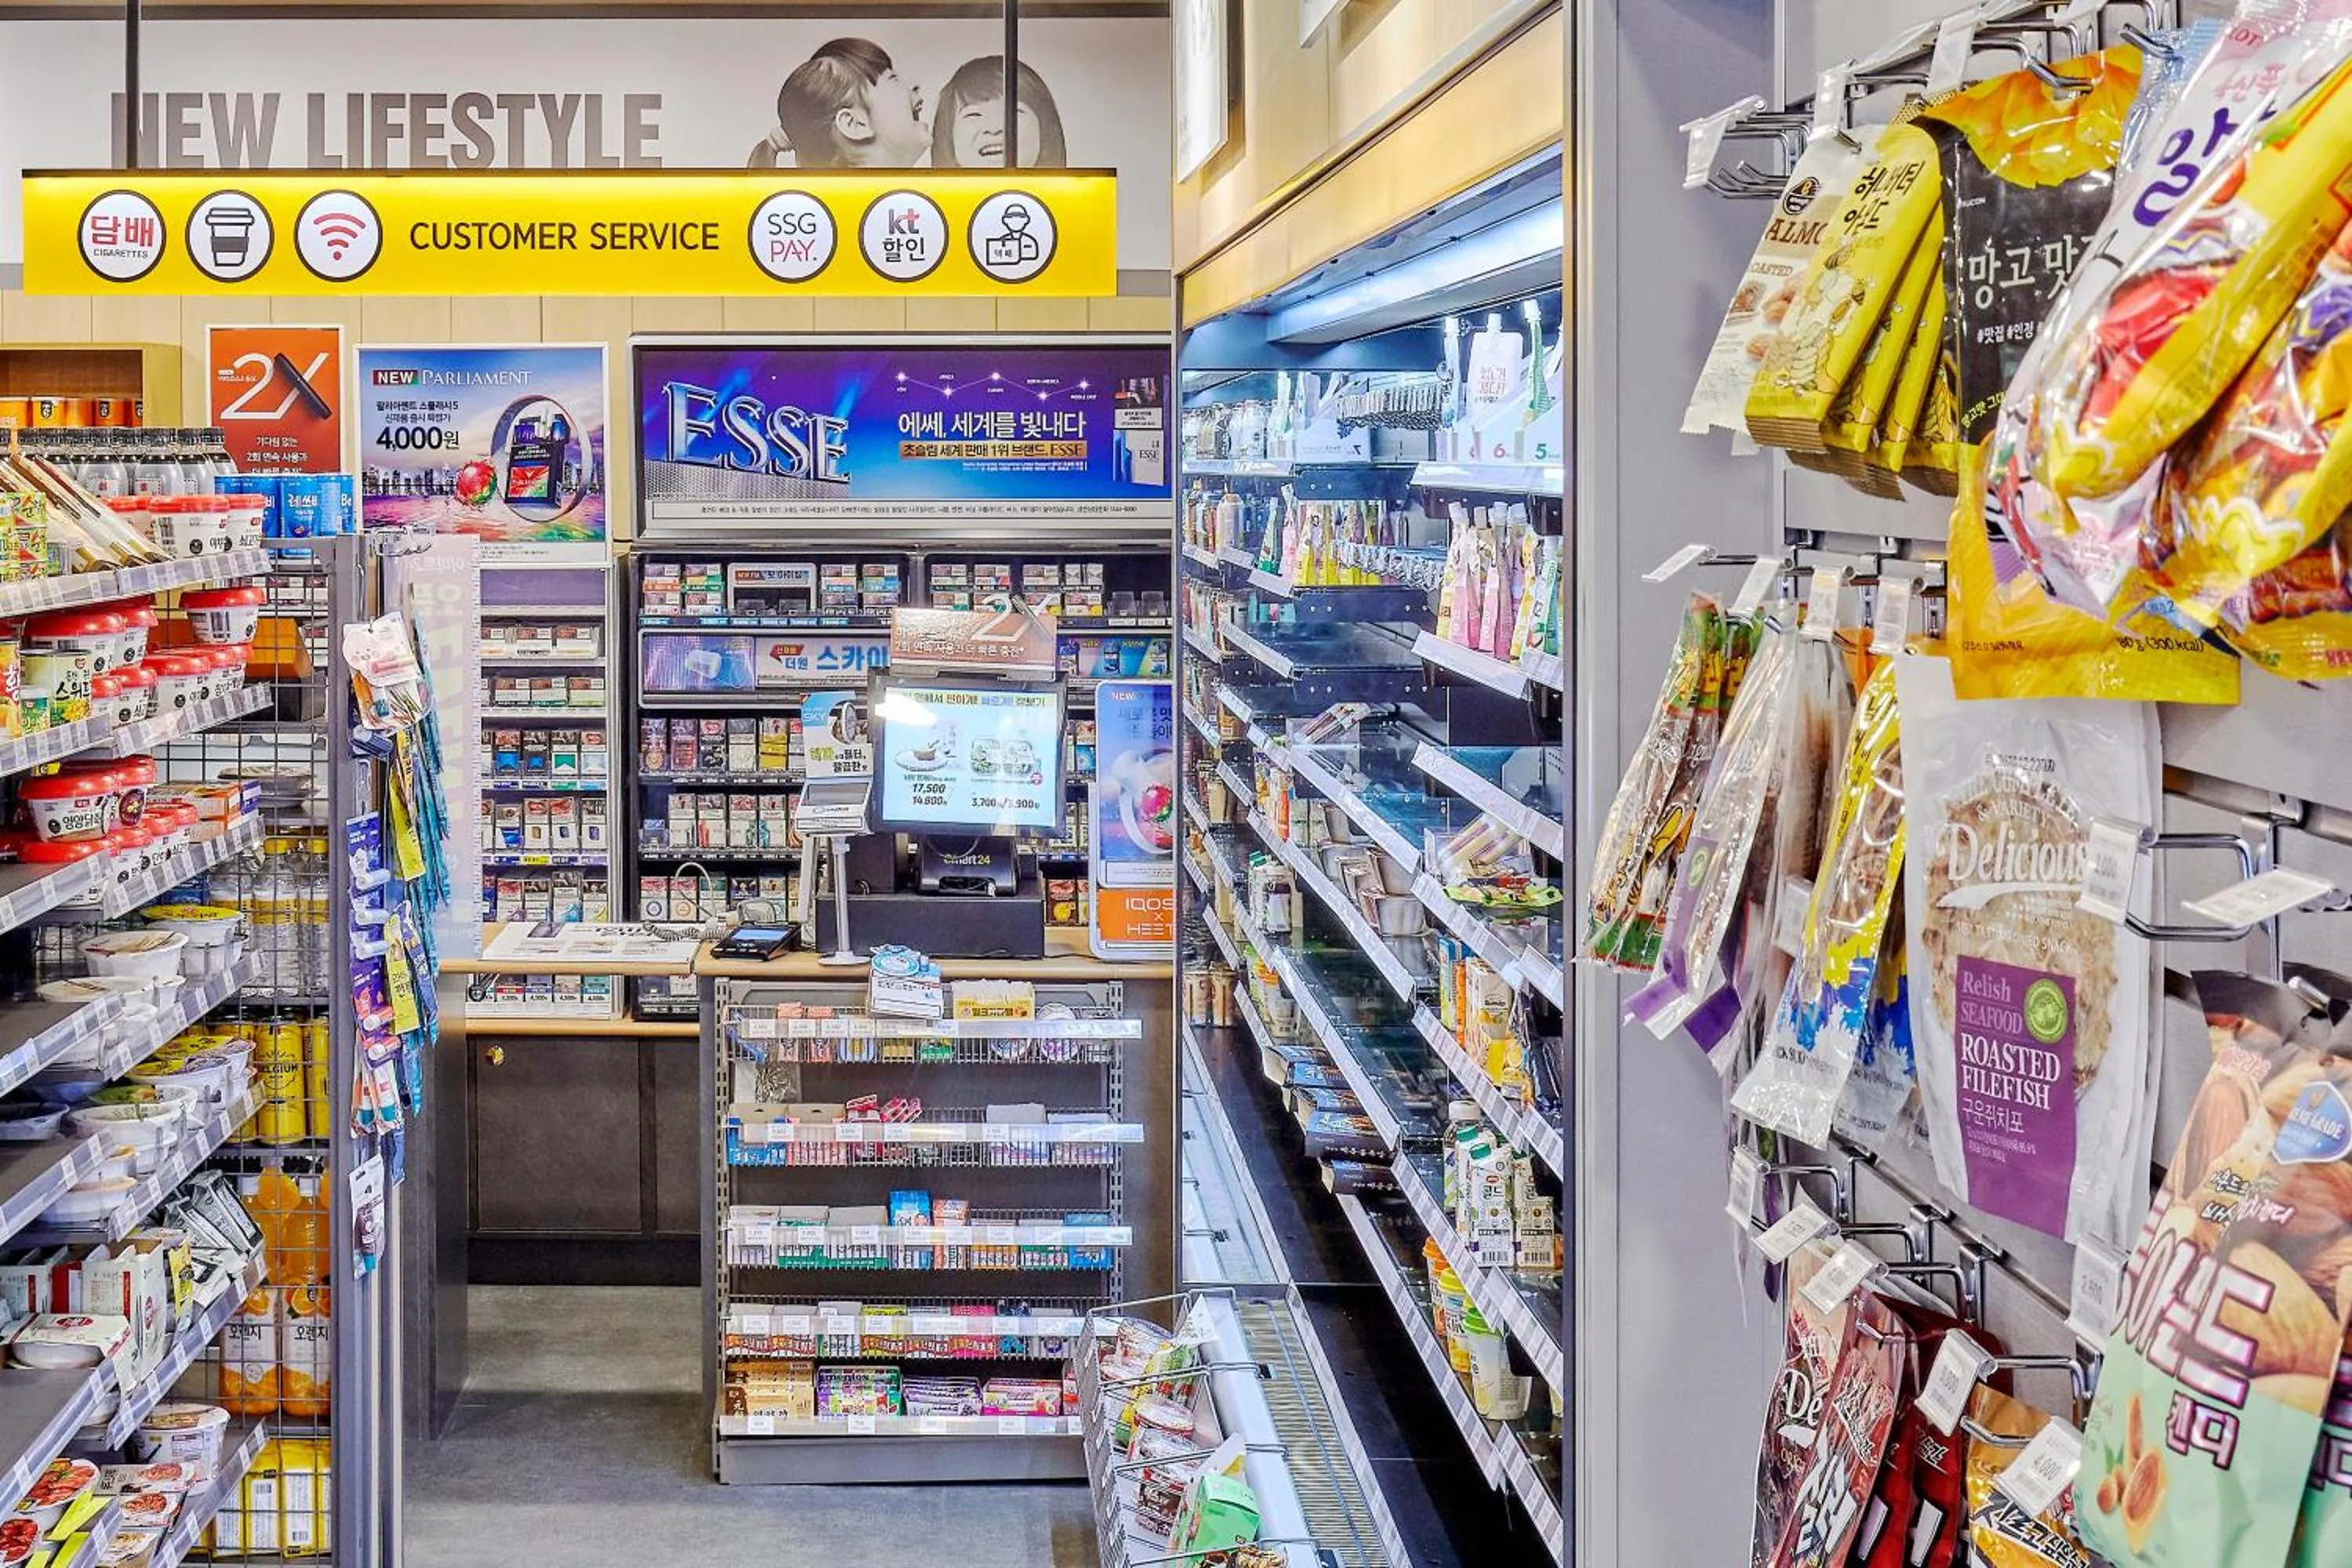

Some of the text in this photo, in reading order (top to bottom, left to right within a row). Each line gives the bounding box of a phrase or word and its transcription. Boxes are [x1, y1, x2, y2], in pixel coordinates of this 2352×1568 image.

[111, 92, 662, 169] NEW LIFESTYLE
[91, 215, 154, 247] 담배
[768, 212, 817, 235] SSG
[887, 208, 920, 234] kt
[410, 222, 720, 250] CUSTOMER SERVICE
[93, 248, 149, 260] CIGARETTES
[882, 237, 925, 263] 할인
[1976, 320, 2034, 345] #맛집 #인정
[378, 370, 533, 385] NEW PARLIAMENT
[662, 381, 851, 485] ESSE
[898, 412, 1087, 438] 에쎄, 세계를 빛내다
[376, 427, 459, 451] 4,000원
[940, 444, 963, 457] 세계
[990, 444, 1009, 457] 1위
[1050, 444, 1084, 457] ESSE
[1494, 443, 1506, 459] 6
[1534, 443, 1547, 459] 5
[1962, 971, 2012, 1003] Relish
[1961, 1001, 2023, 1036] SEAFOOD
[1961, 1033, 2062, 1083] ROASTED
[1962, 1065, 2051, 1111] FILEFISH
[228, 1324, 262, 1341] 오렌지
[294, 1325, 329, 1341] 오렌지
